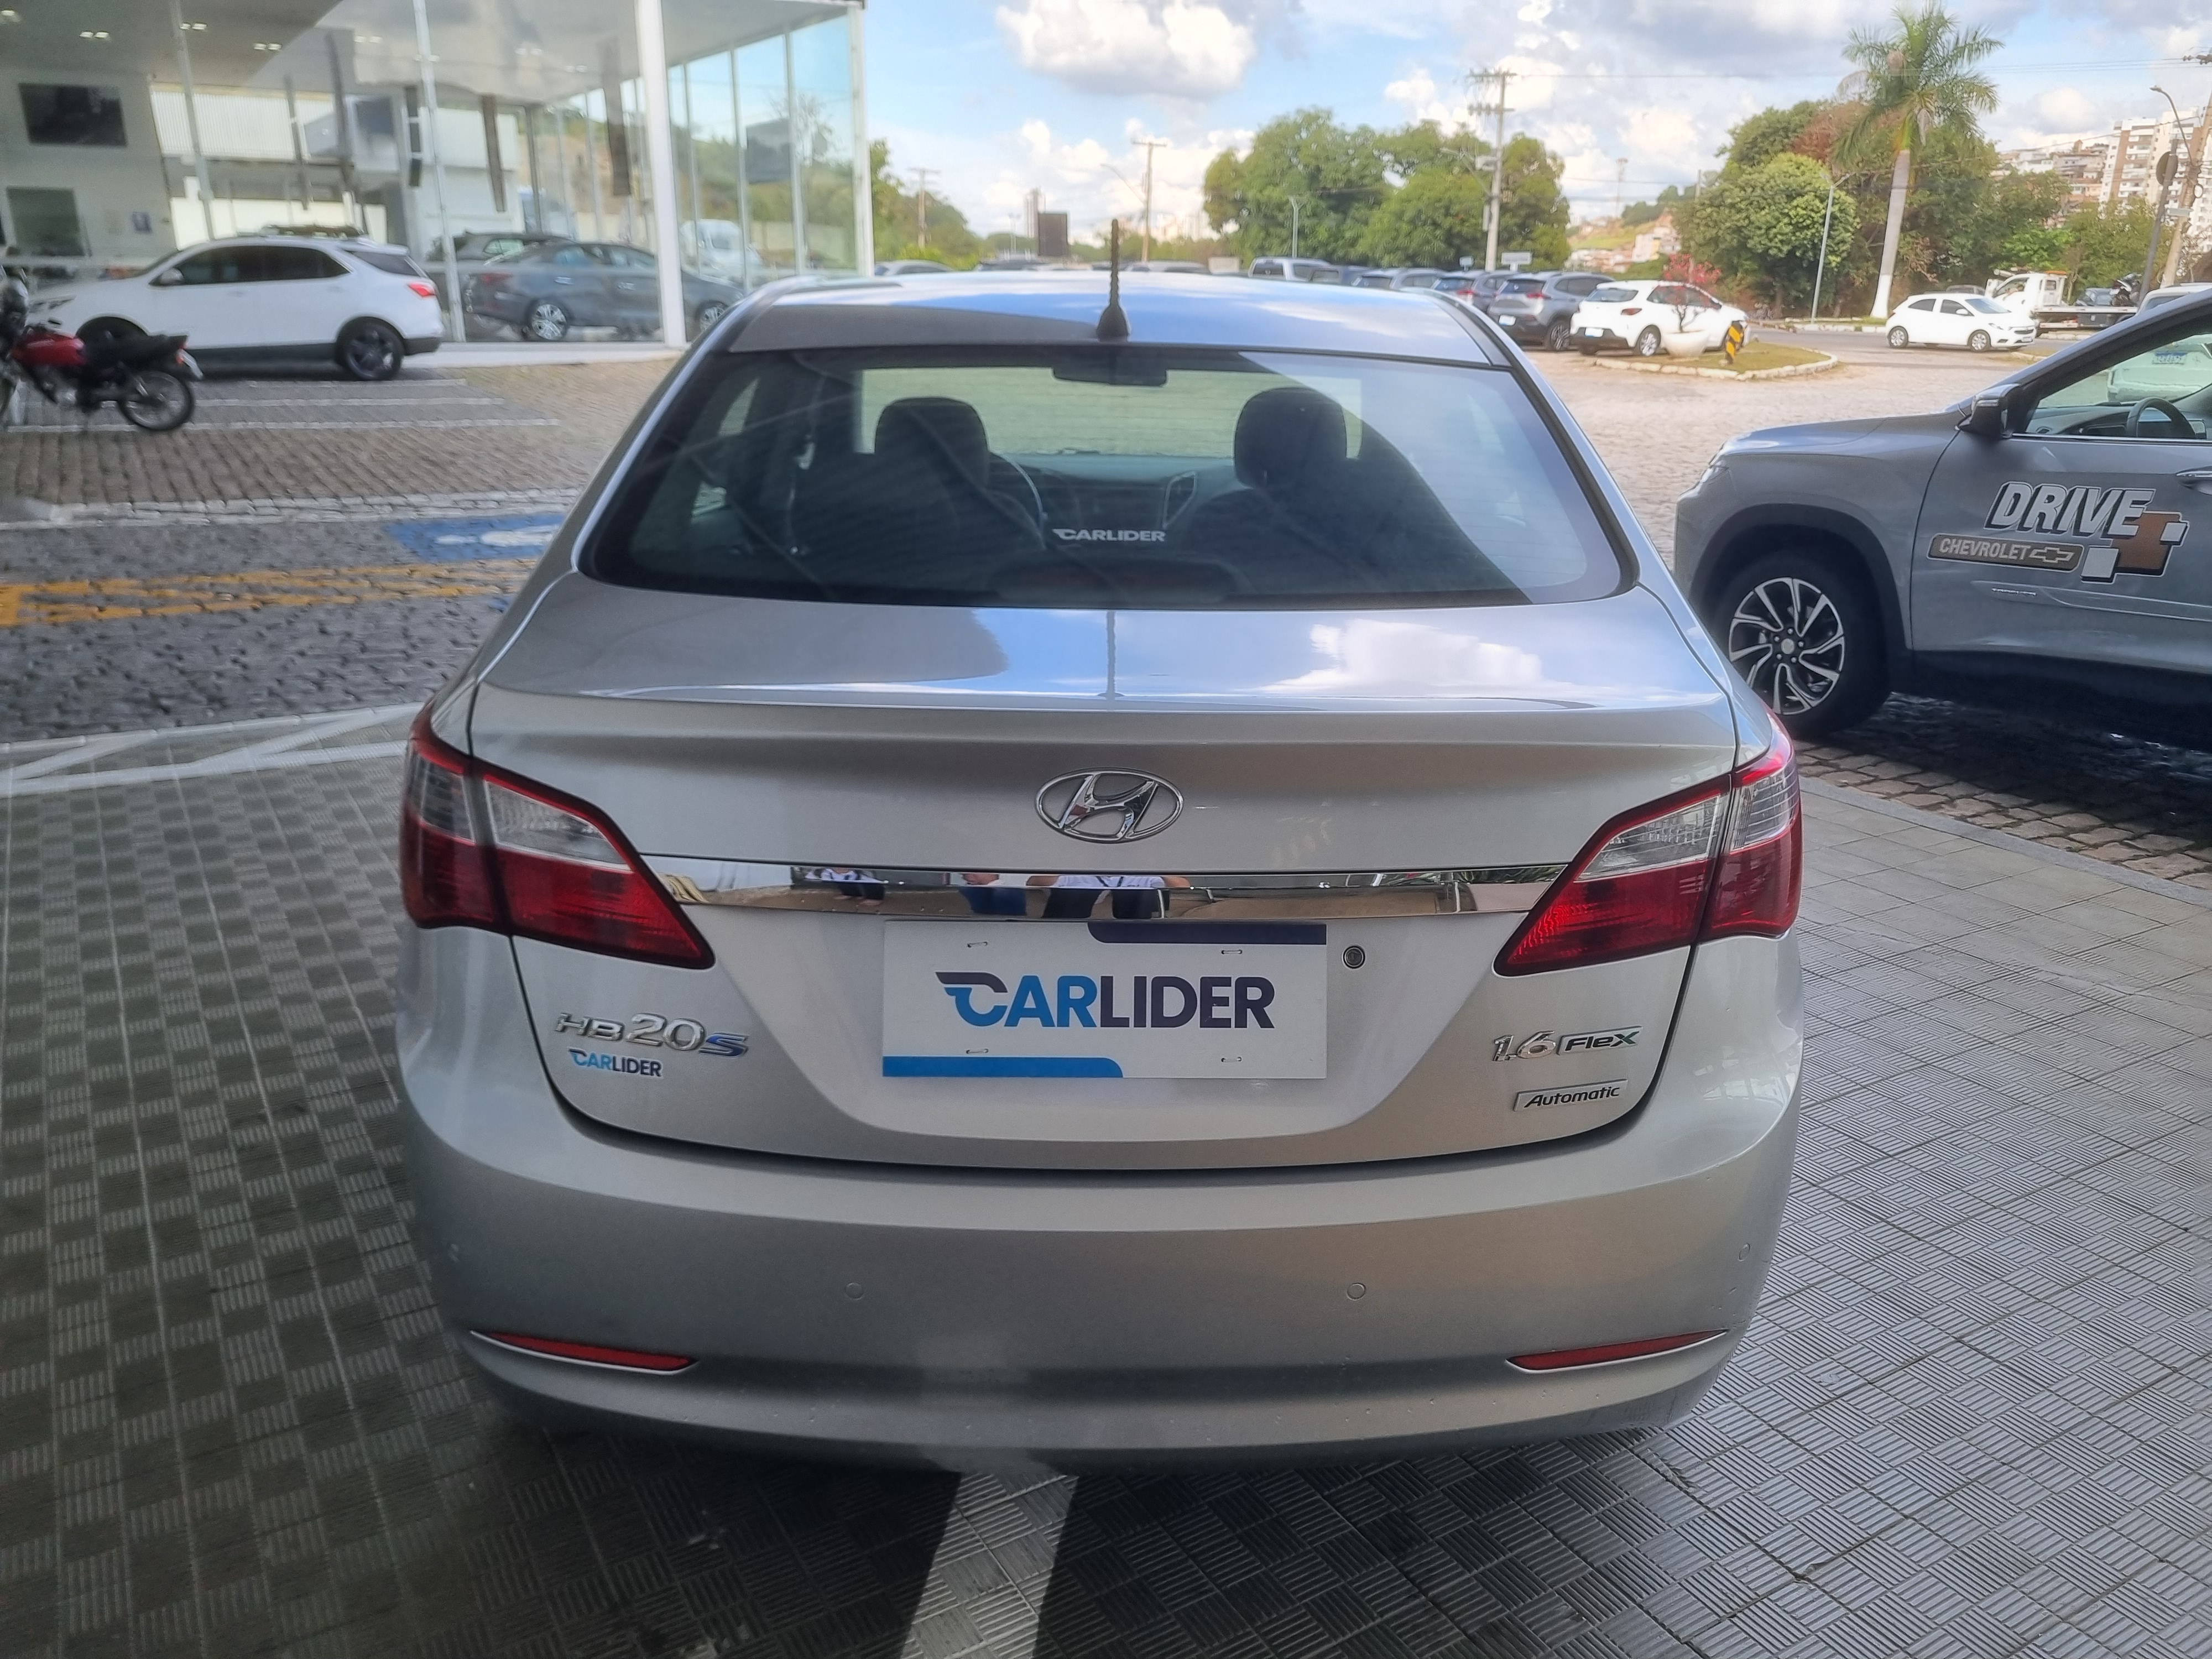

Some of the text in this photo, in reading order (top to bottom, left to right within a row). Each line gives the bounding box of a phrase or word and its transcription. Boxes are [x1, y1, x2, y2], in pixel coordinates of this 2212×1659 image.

[1984, 482, 2156, 539] DRIVE
[1052, 529, 1166, 542] CARLIDER
[1939, 538, 2031, 561] CHEVROLET
[935, 972, 1275, 1029] CARLIDER
[1493, 1030, 1557, 1062] 1.6
[568, 1047, 662, 1077] CARLIDER
[1524, 1086, 1621, 1108] Automatic
